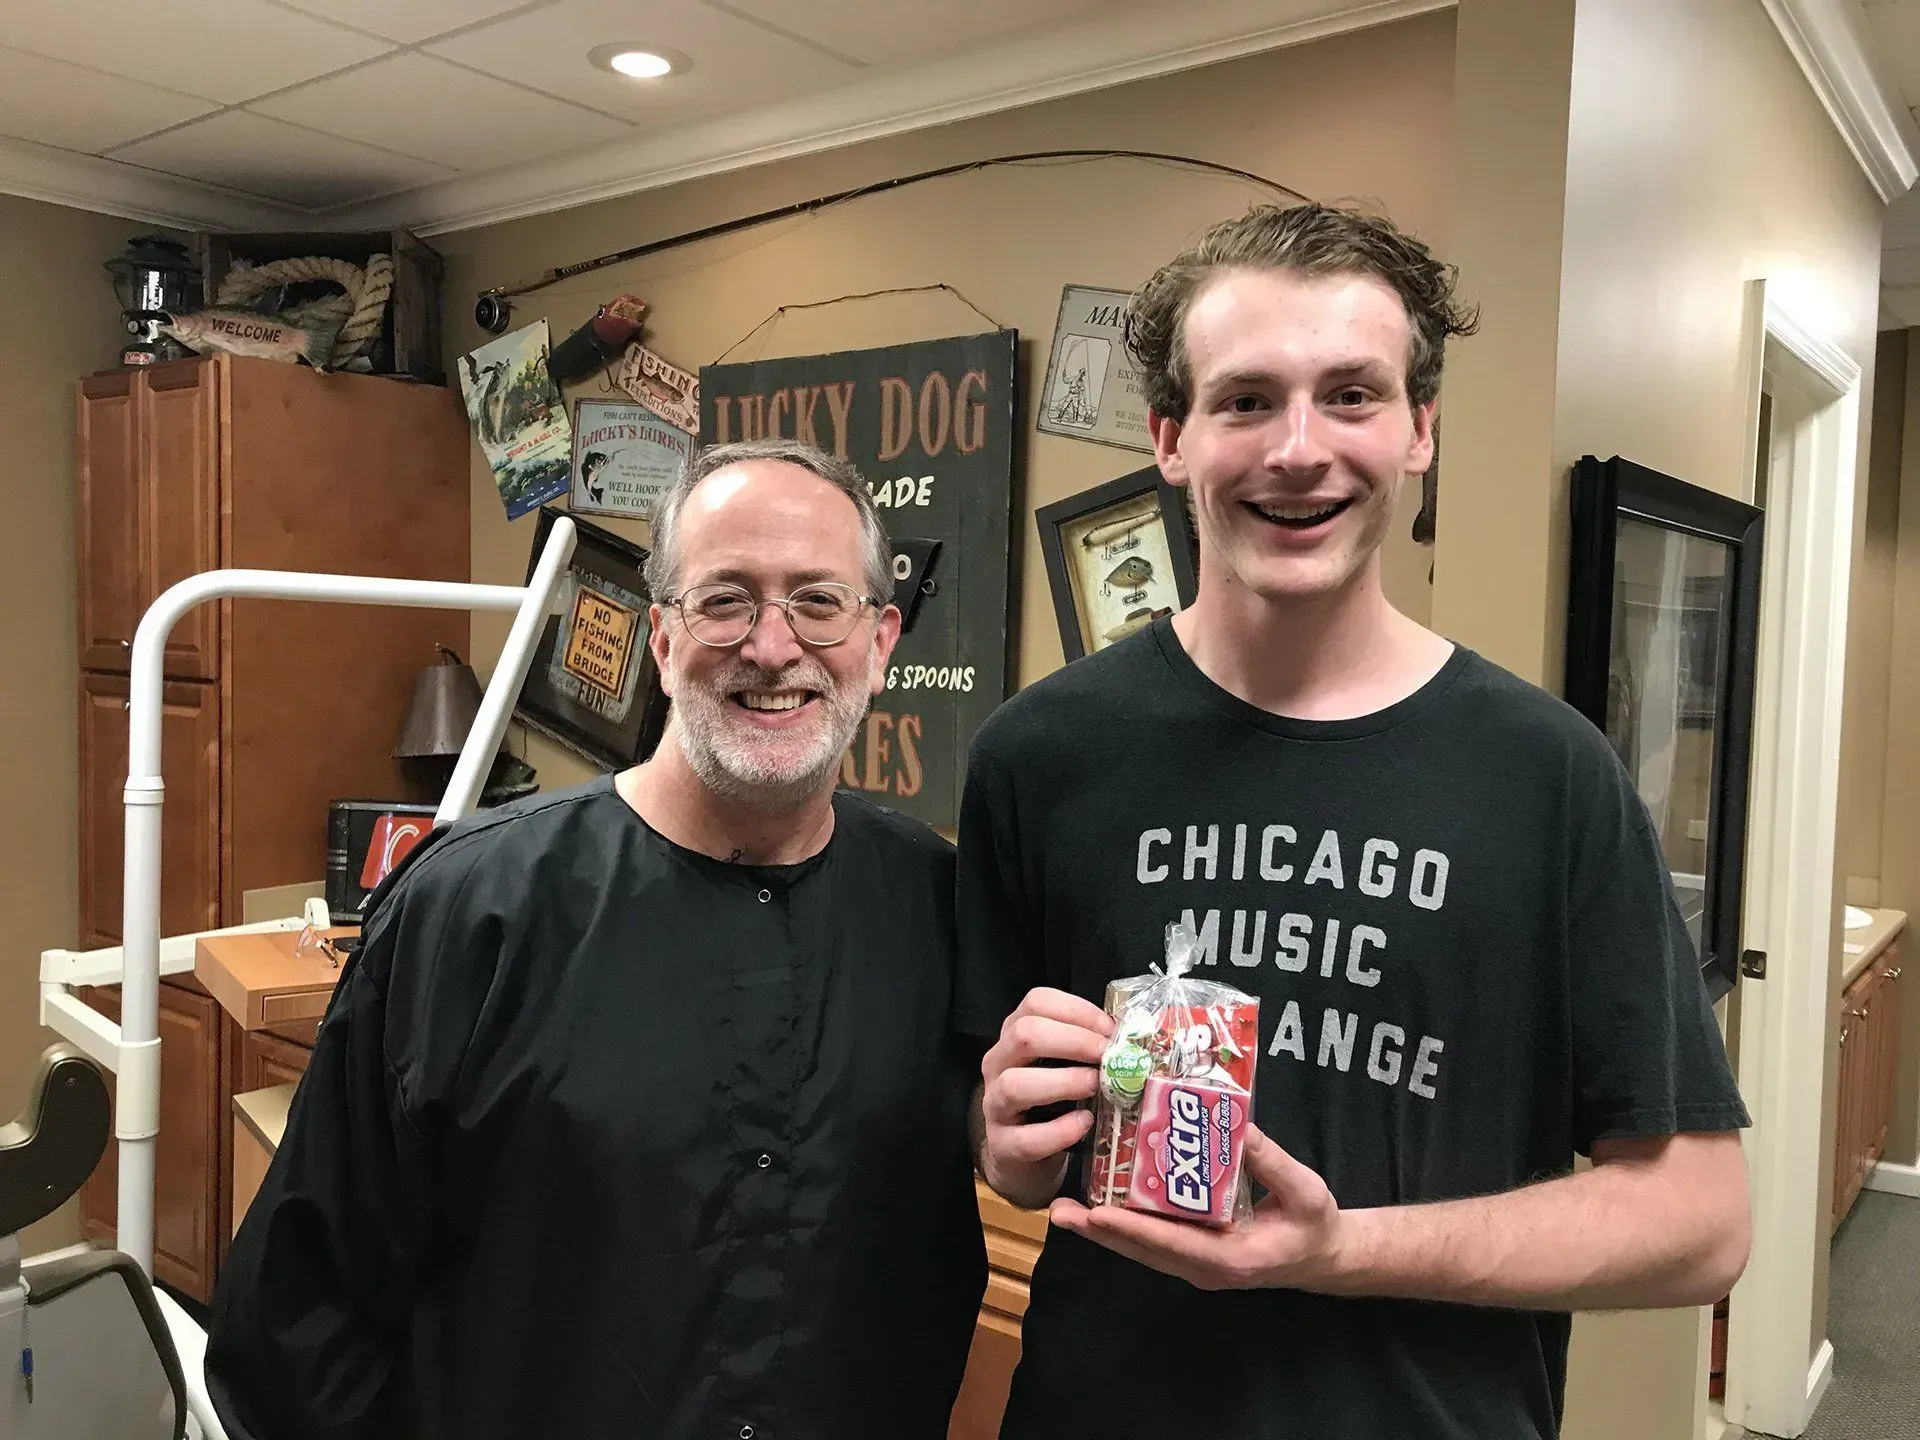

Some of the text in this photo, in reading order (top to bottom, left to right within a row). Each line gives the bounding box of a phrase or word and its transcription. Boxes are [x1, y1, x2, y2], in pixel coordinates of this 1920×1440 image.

[212, 317, 281, 343] WELCOME
[604, 411, 618, 420] FISH
[629, 383, 683, 422] EXPEDITIONS
[714, 369, 987, 462] LUCKY DOG
[581, 424, 686, 457] LUCKY'S LURES
[612, 495, 629, 506] YOU
[635, 484, 661, 495] HOOK
[867, 476, 935, 508] ADE
[594, 606, 611, 626] NO
[578, 618, 623, 651] FISHING
[581, 638, 613, 665] FROM
[573, 654, 615, 685] BRIDGE
[886, 665, 975, 693] & SPOONS
[577, 680, 607, 712] FUN
[1137, 824, 1450, 911] CHICAGO
[1180, 908, 1387, 988] MUSIC
[1268, 1000, 1445, 1099] ANGE
[1201, 1106, 1209, 1134] FLAVOR
[1219, 1092, 1231, 1165] CLASSIC BUBBLE
[1168, 1088, 1210, 1213] Extra
[1202, 1163, 1210, 1182] LONG
